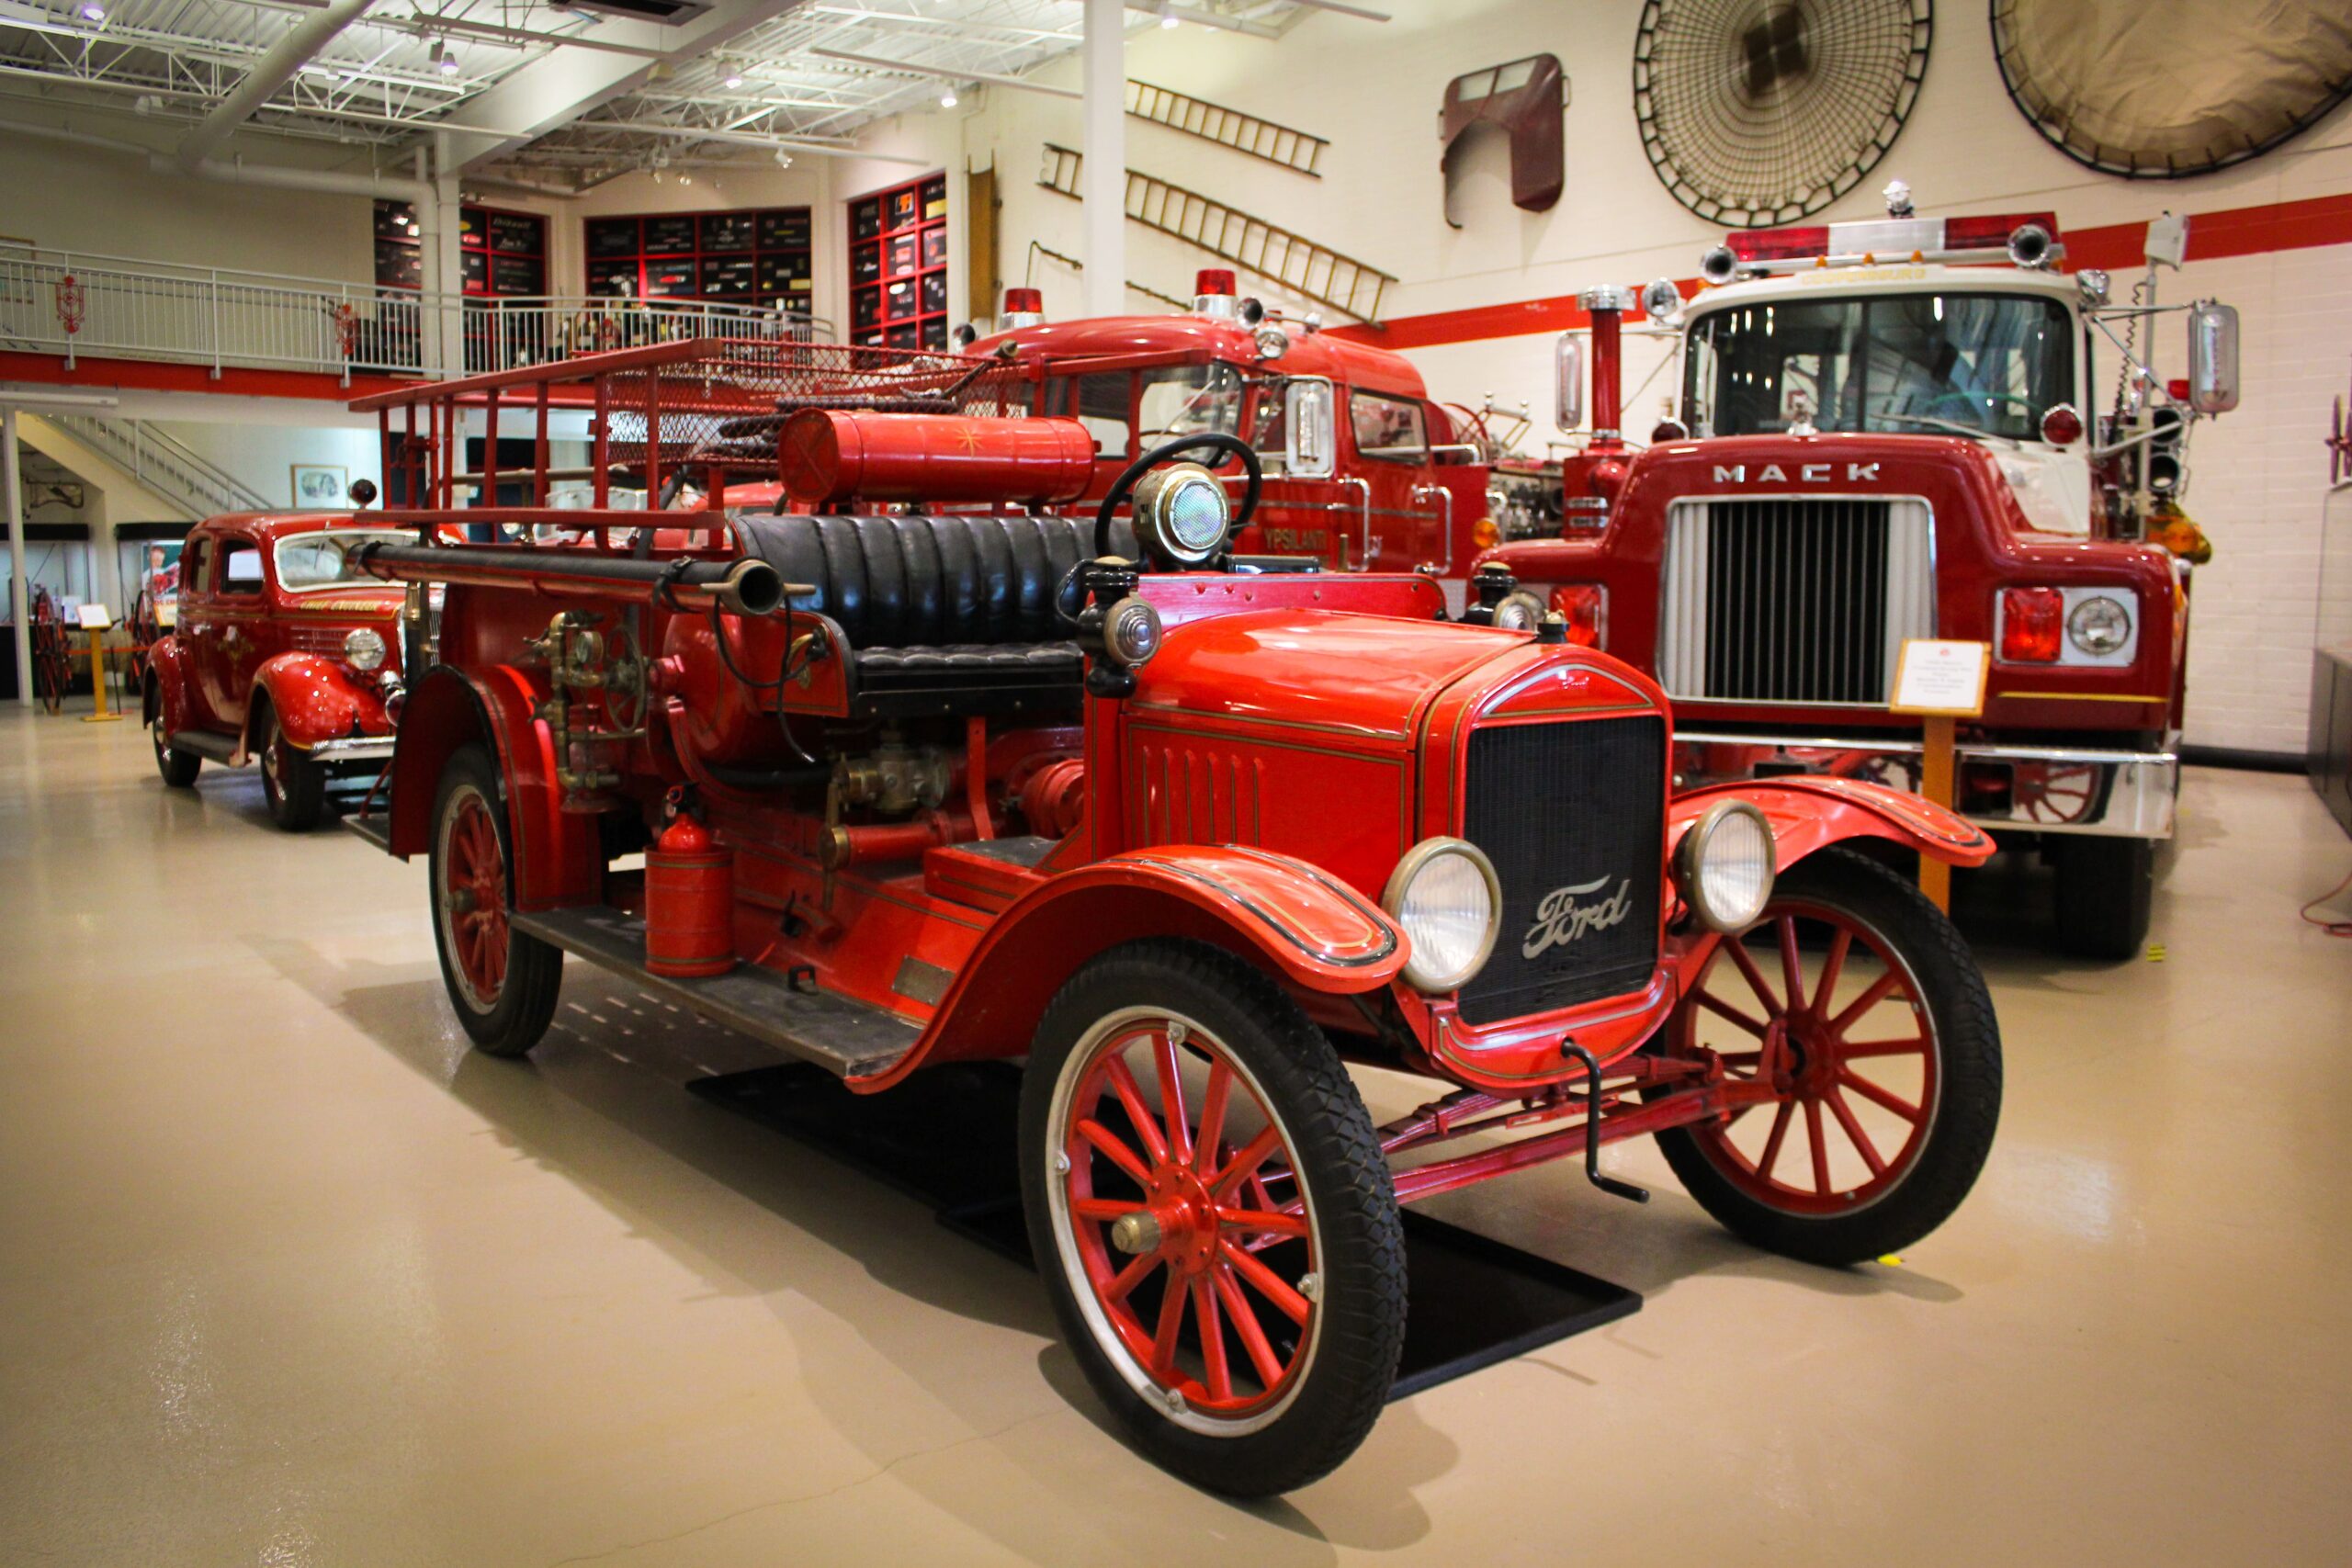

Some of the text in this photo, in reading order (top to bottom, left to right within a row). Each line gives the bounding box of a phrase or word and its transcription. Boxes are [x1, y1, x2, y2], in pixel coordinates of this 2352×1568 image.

[1713, 463, 1880, 482] MACK
[1264, 529, 1327, 550] YPSILANTI
[1522, 874, 1632, 960] Ford
